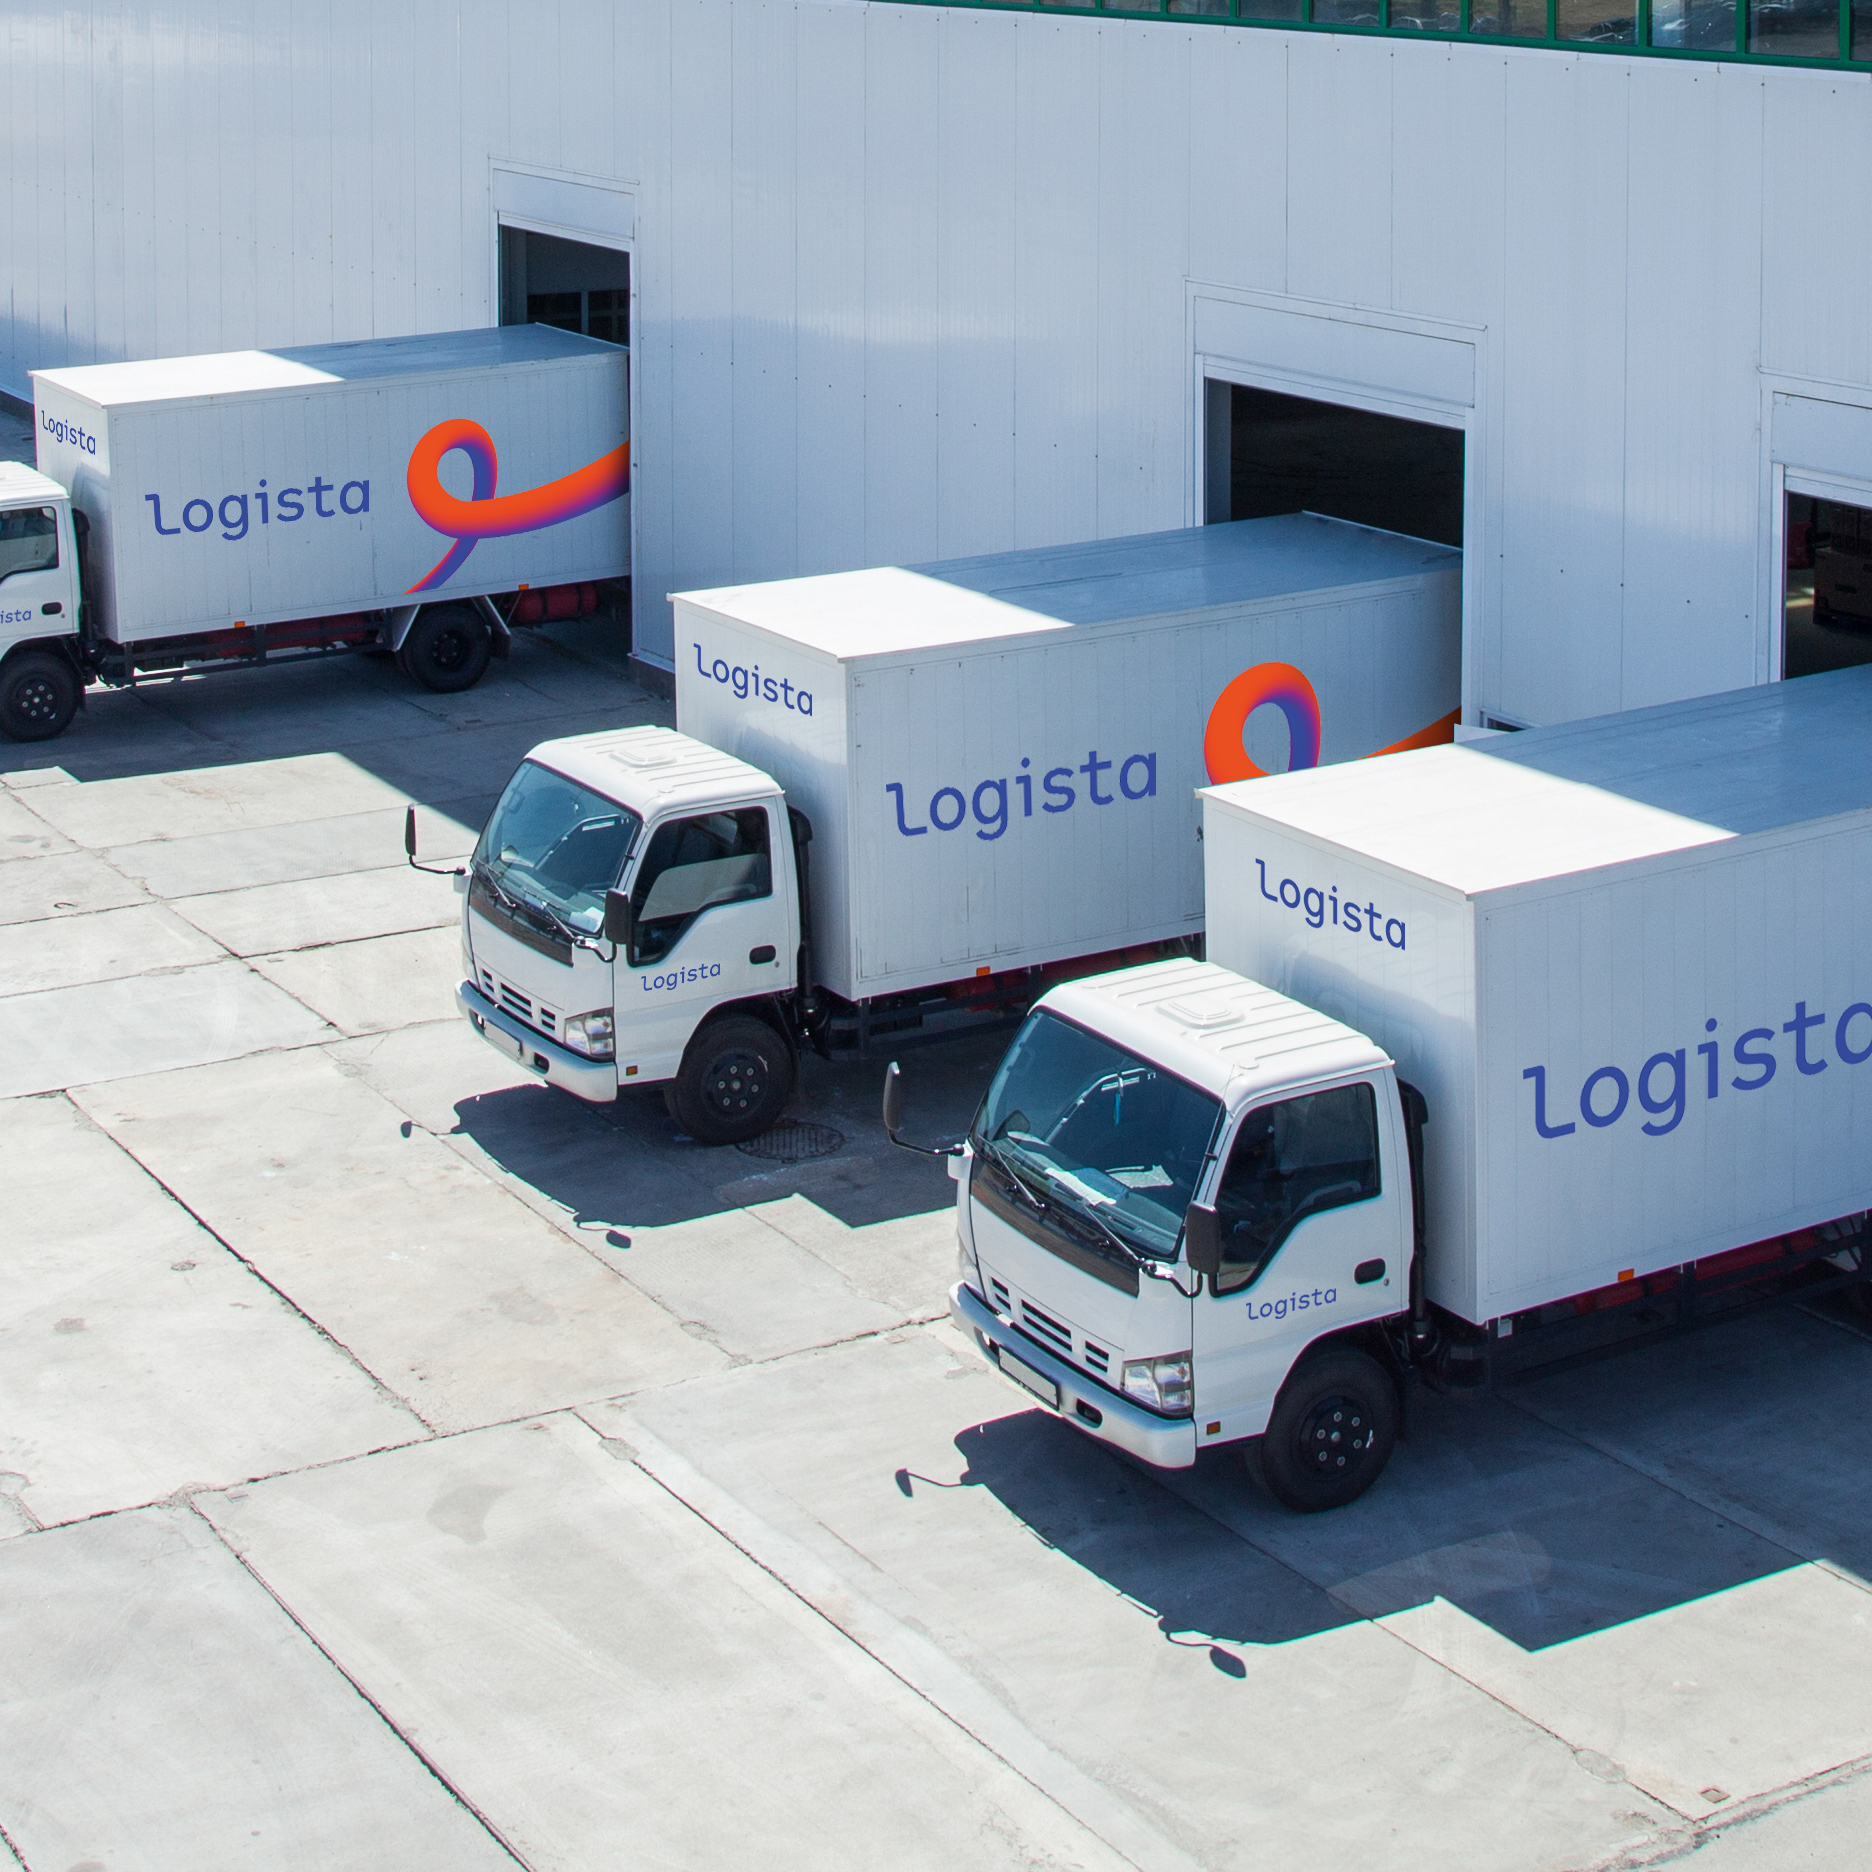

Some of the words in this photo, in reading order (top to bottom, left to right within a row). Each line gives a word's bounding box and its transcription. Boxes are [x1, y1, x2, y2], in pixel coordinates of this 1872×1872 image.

[40, 410, 96, 456] logista
[144, 476, 370, 542] logista
[693, 642, 813, 717] logista
[885, 750, 1157, 841] logista
[1255, 857, 1406, 951] logista
[640, 962, 721, 992] logista
[1245, 1287, 1337, 1321] logista
